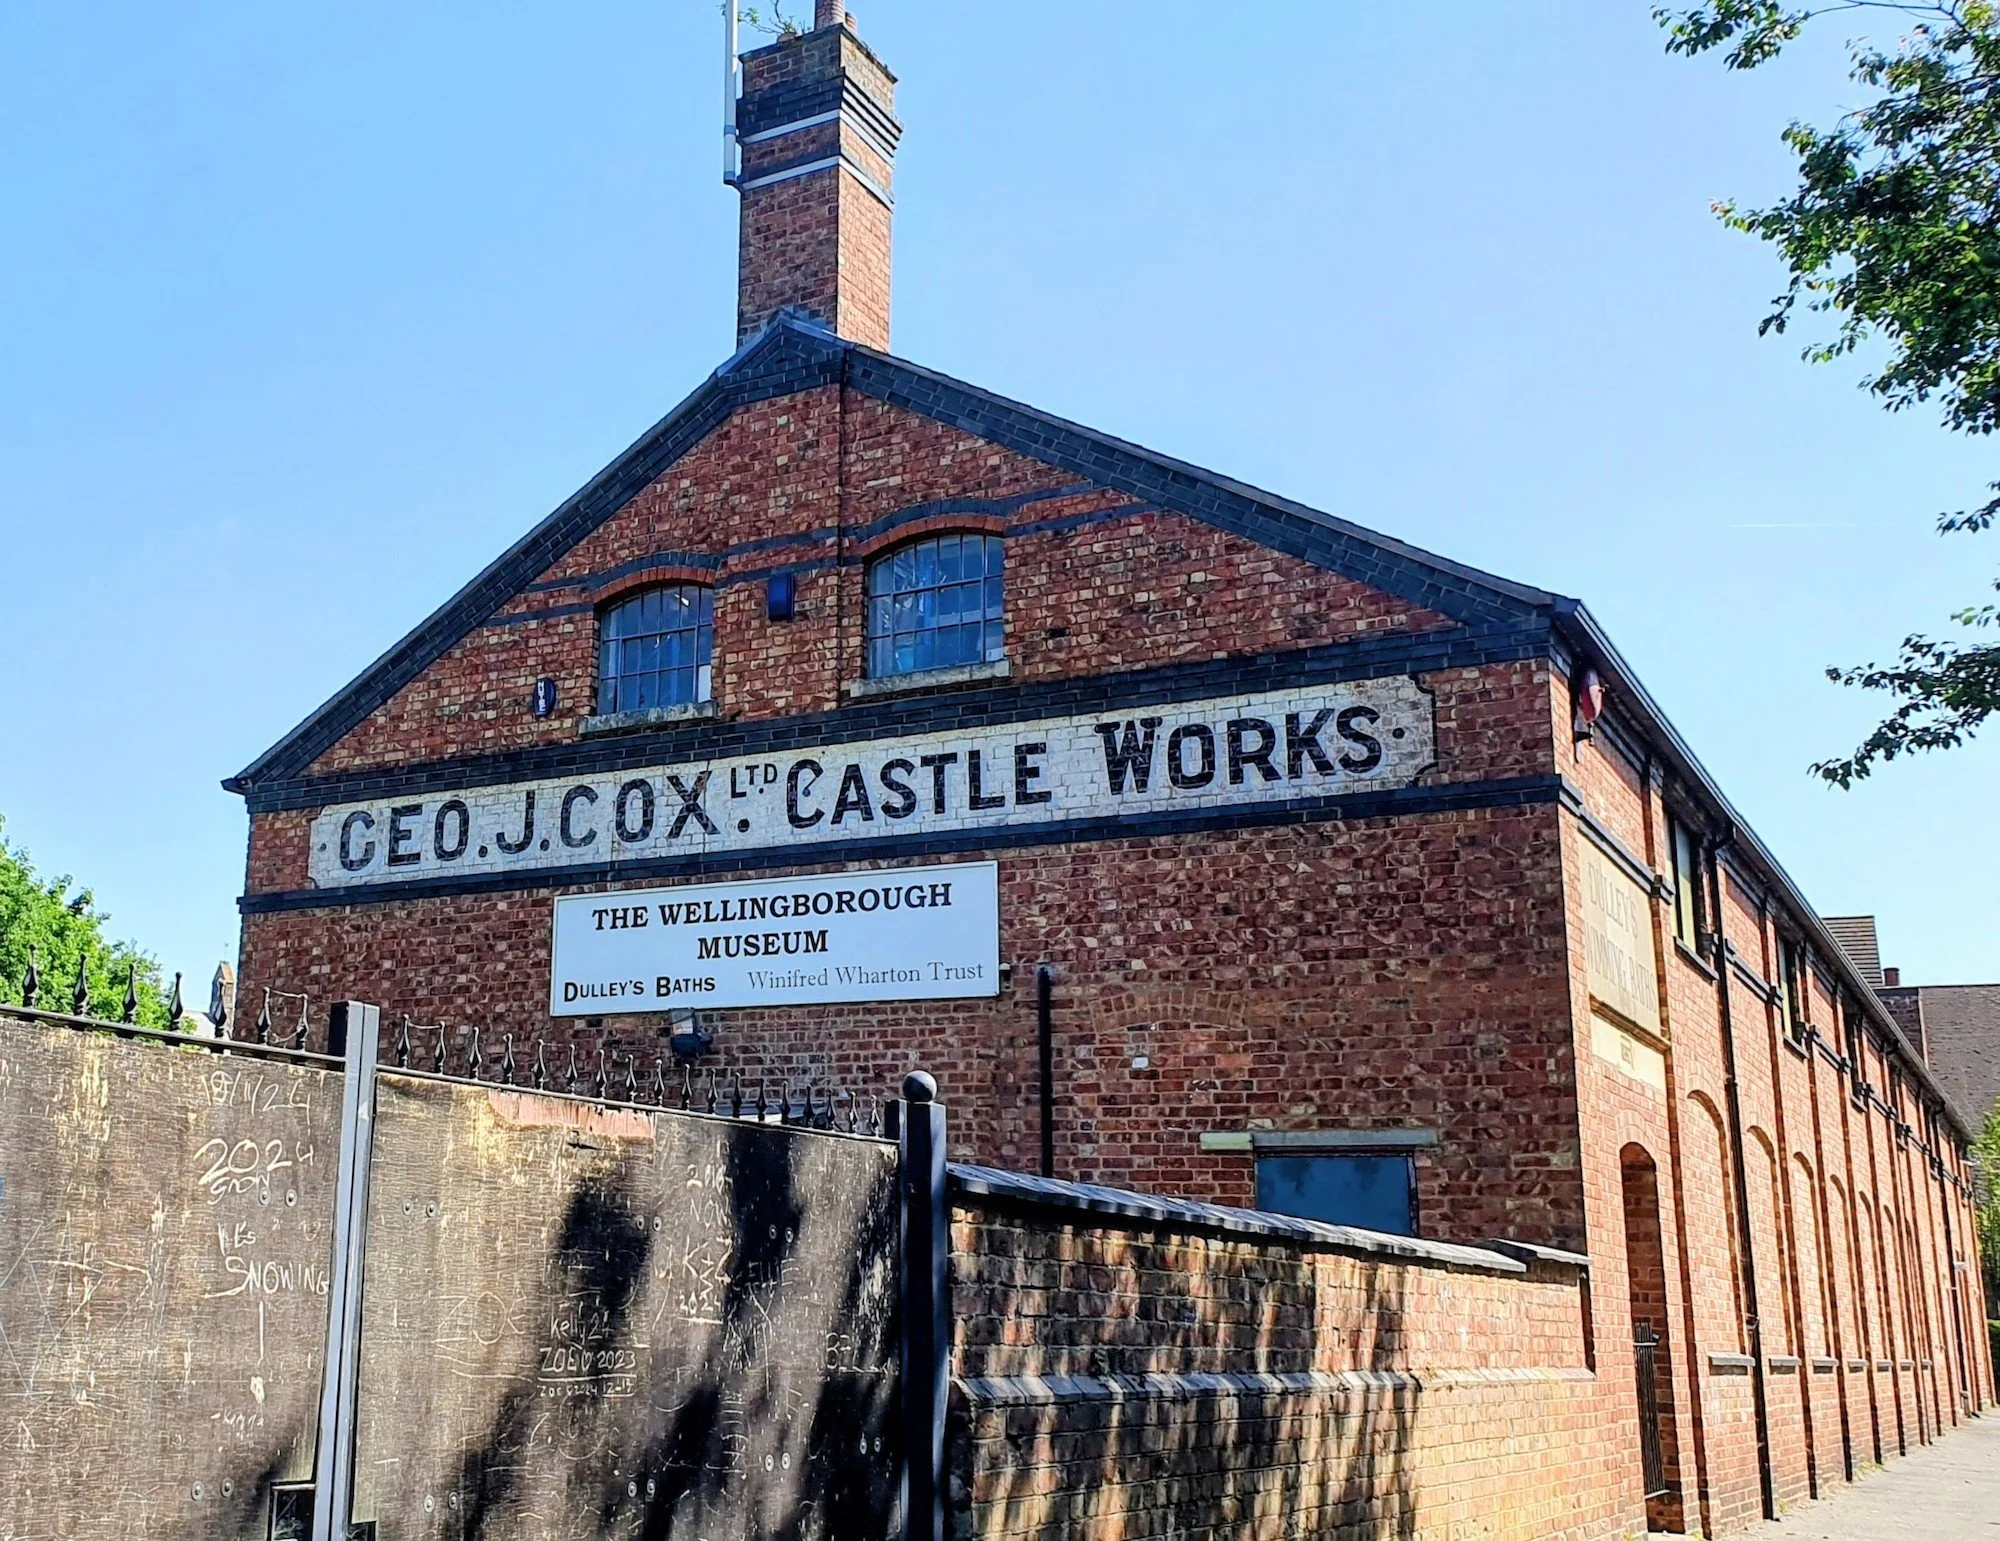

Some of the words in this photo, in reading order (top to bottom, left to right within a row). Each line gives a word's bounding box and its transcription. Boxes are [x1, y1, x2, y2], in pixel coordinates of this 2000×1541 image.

[786, 742, 1052, 829] CASTLE
[592, 906, 649, 931] THE
[658, 882, 952, 926] WELLINGBOROUGH
[697, 929, 829, 960] MUSEUM
[747, 968, 828, 990] Winifred
[835, 965, 921, 986] Wharton
[927, 961, 984, 982] Trust
[193, 1137, 314, 1185] 2024
[204, 1255, 330, 1298] SNOWING
[596, 1349, 637, 1370] 2023
